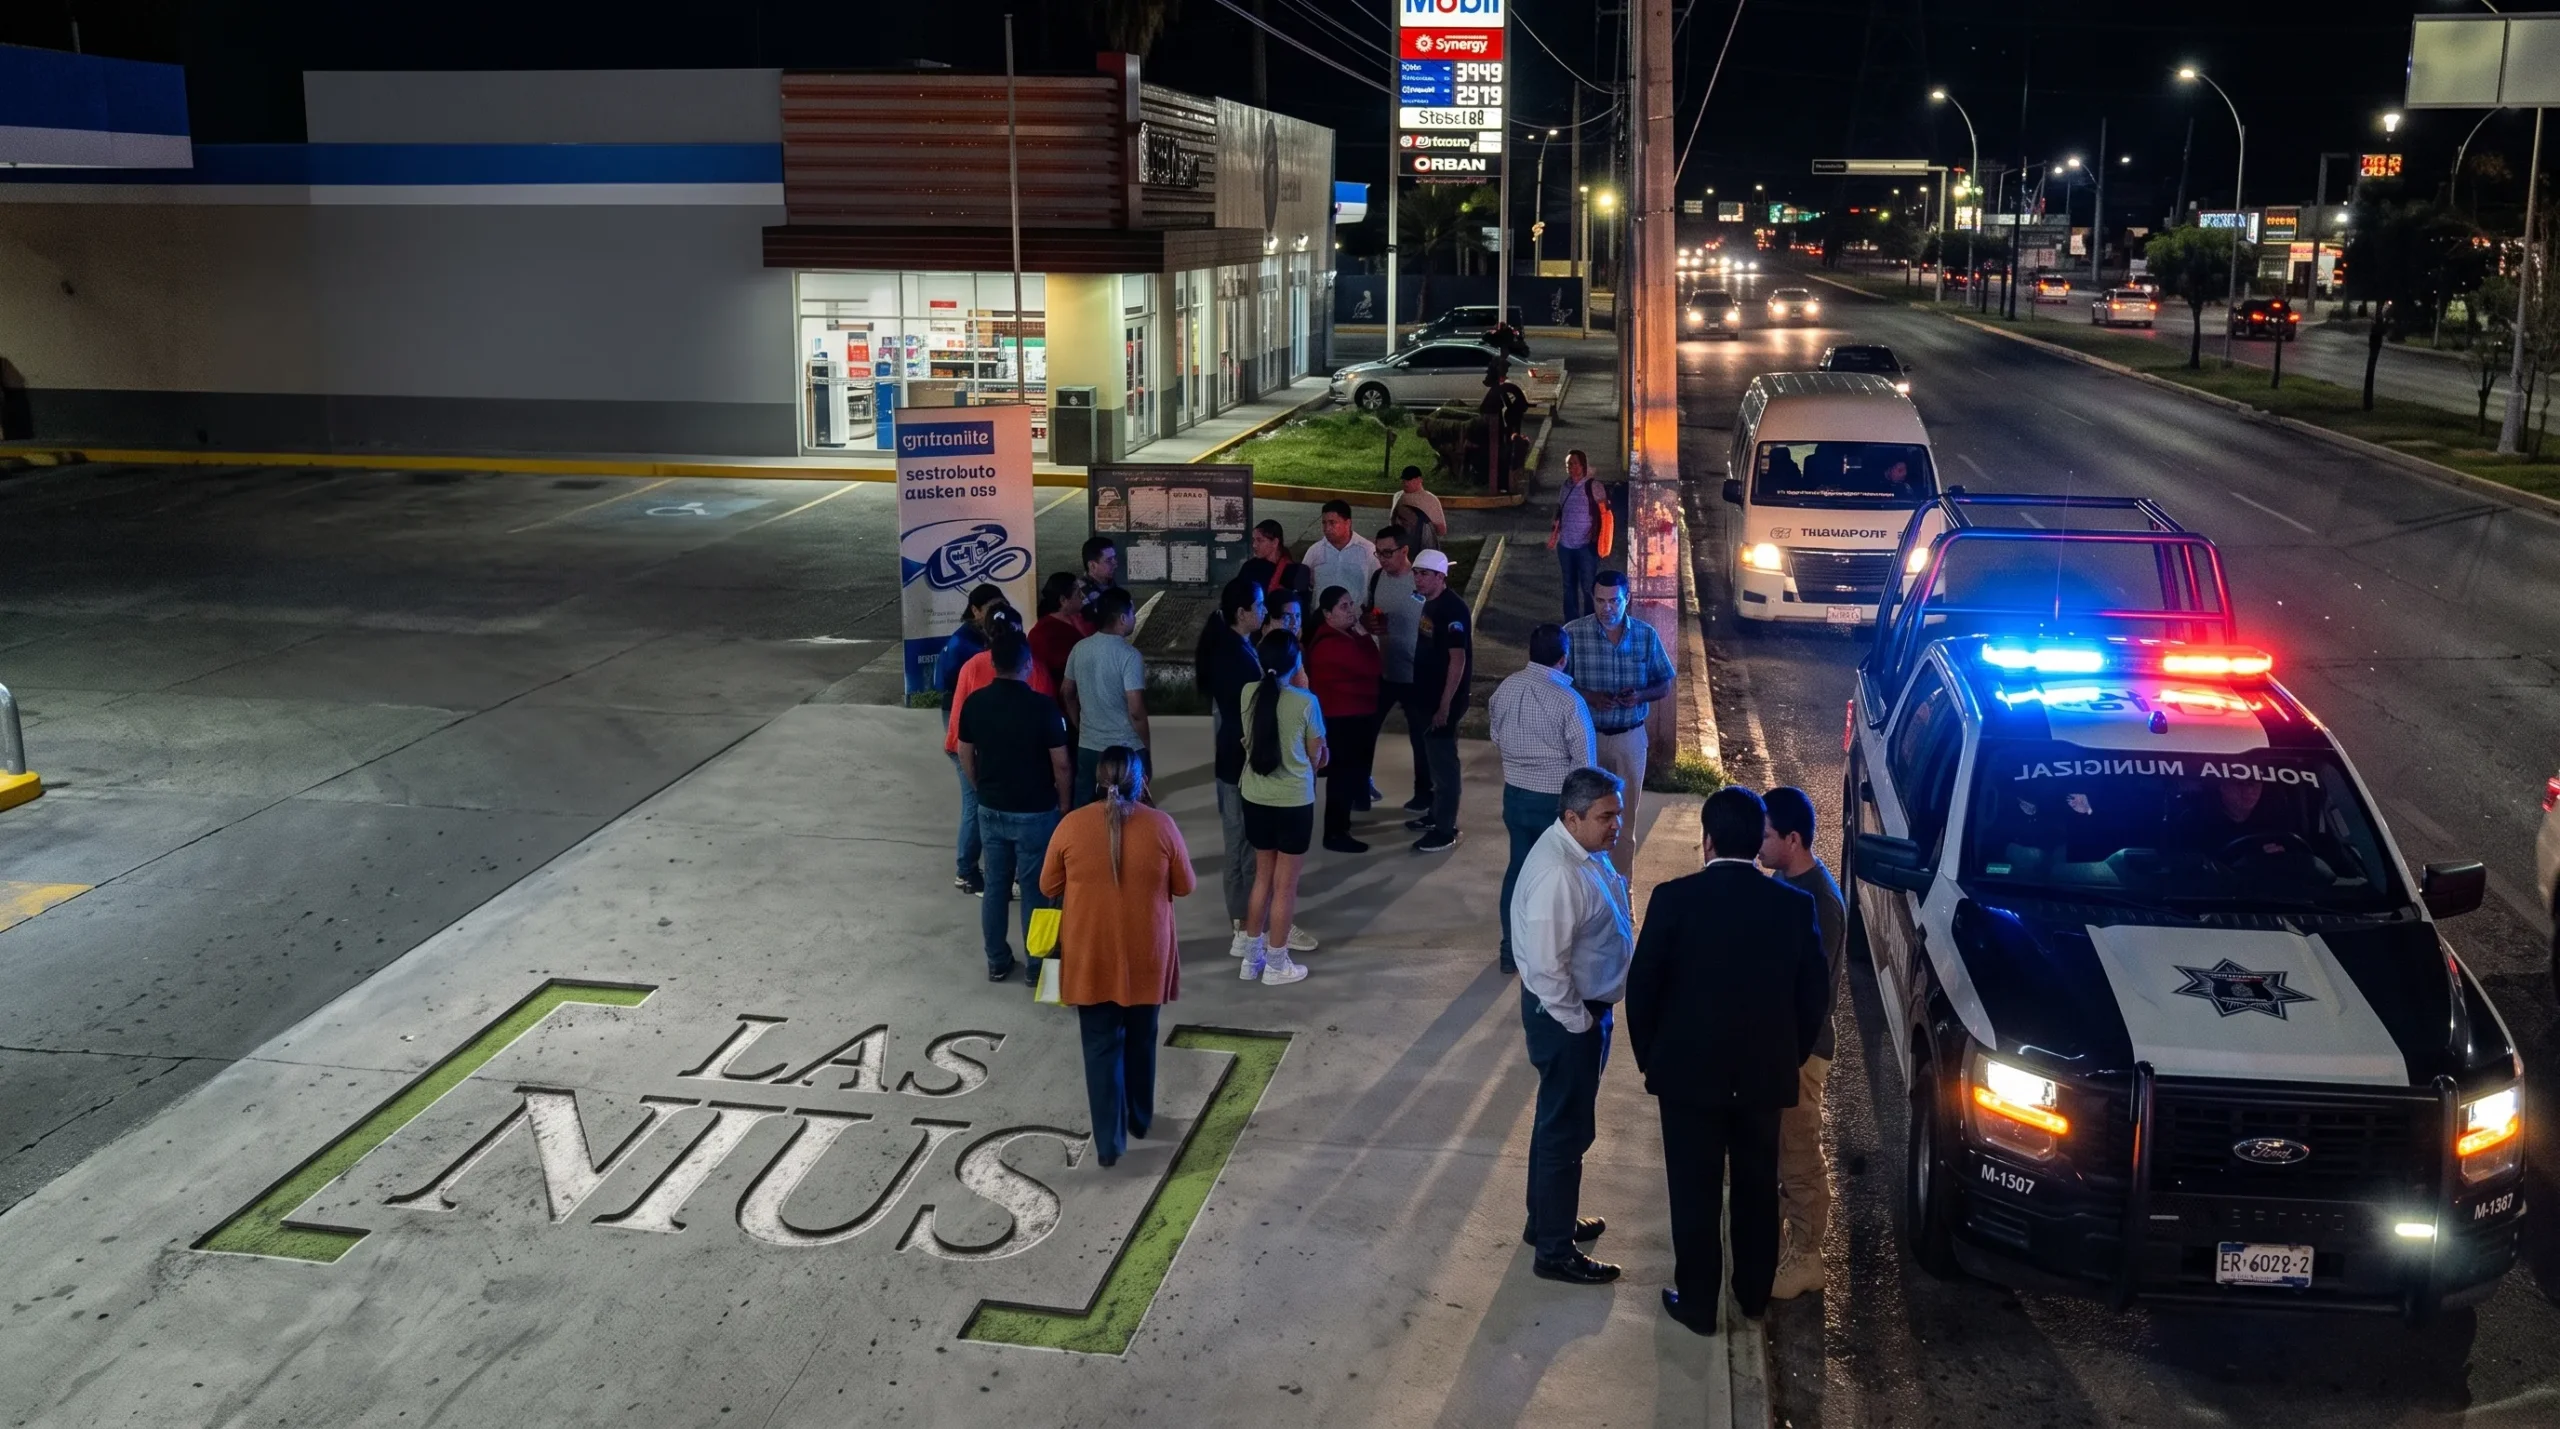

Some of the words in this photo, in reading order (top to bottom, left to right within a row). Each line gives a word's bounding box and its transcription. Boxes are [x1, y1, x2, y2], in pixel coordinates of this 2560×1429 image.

[1436, 38, 1488, 53] Synergy
[1456, 62, 1502, 82] 3949
[1414, 157, 1486, 171] ORBAN
[677, 1013, 1006, 1098] LAS
[384, 1084, 1091, 1262] NIUS
[1981, 1164, 2035, 1194] M-1507
[2474, 1192, 2514, 1220] M-1387
